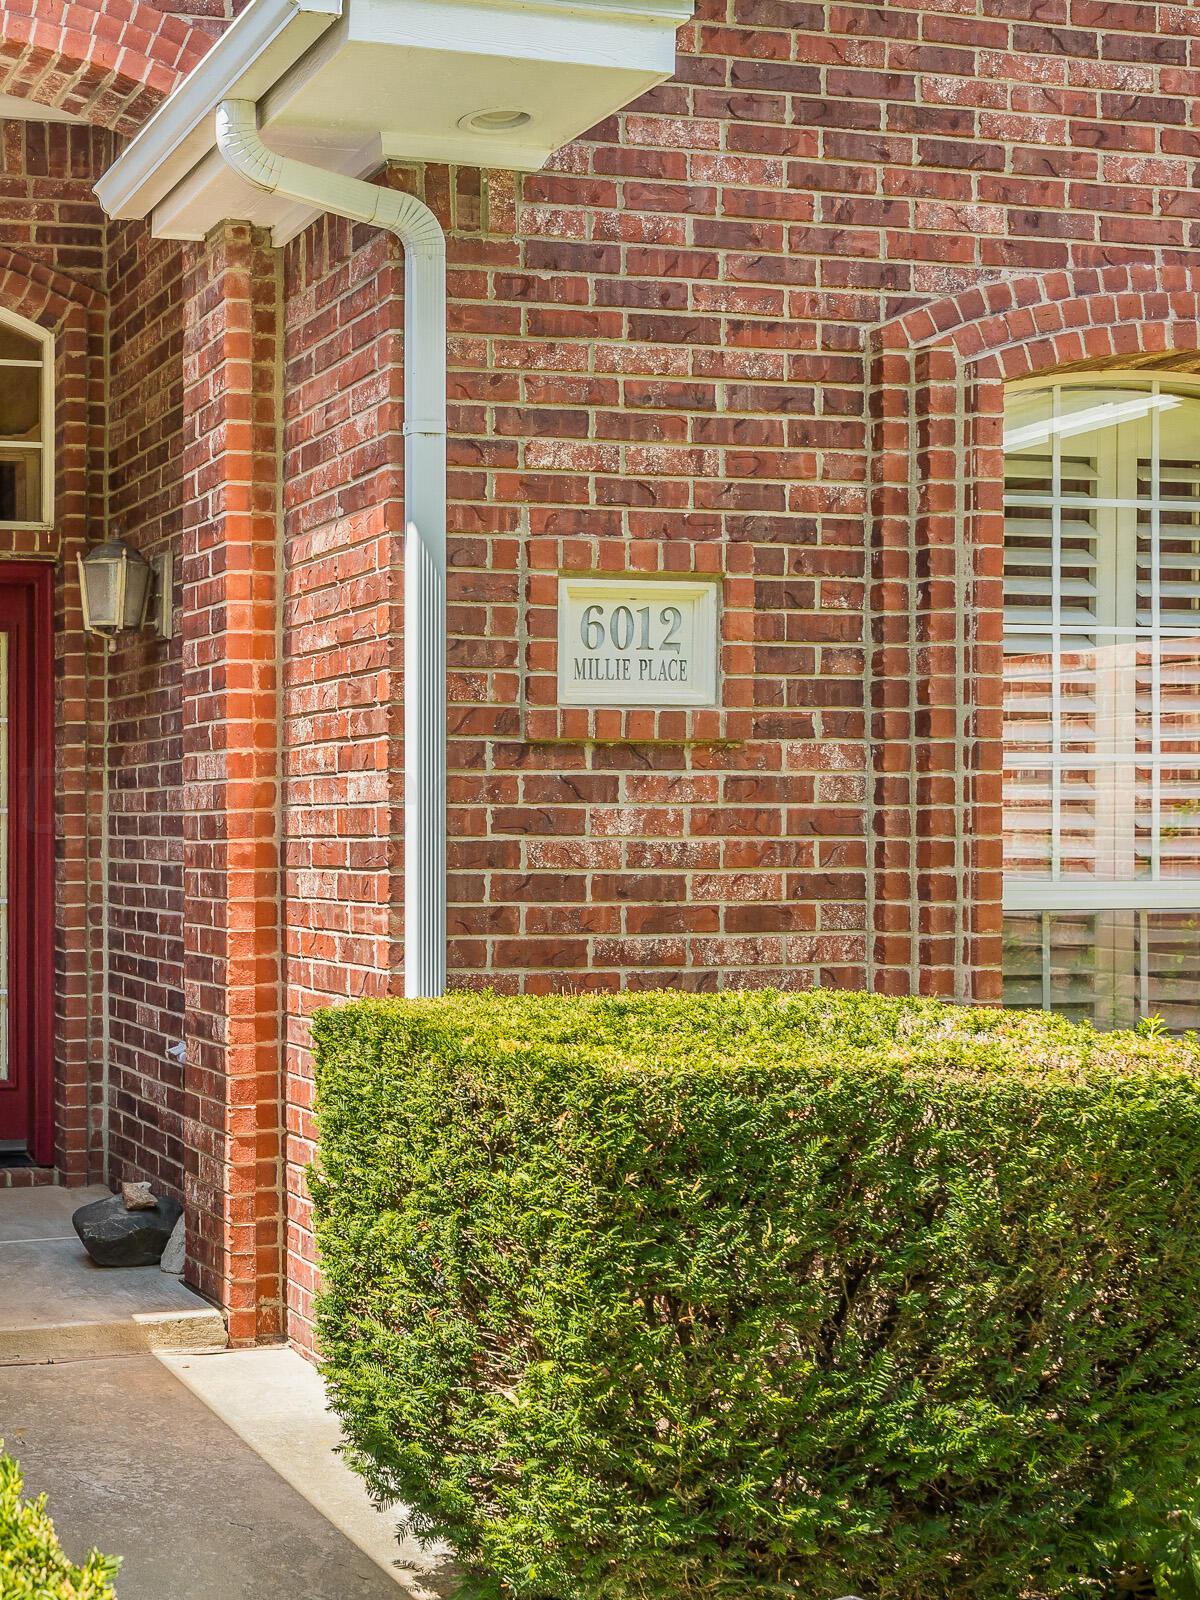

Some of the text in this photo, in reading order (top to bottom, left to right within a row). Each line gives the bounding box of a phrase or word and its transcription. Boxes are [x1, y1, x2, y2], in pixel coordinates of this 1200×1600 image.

[580, 604, 682, 654] 6012
[574, 657, 688, 682] MILLIE PLACE
